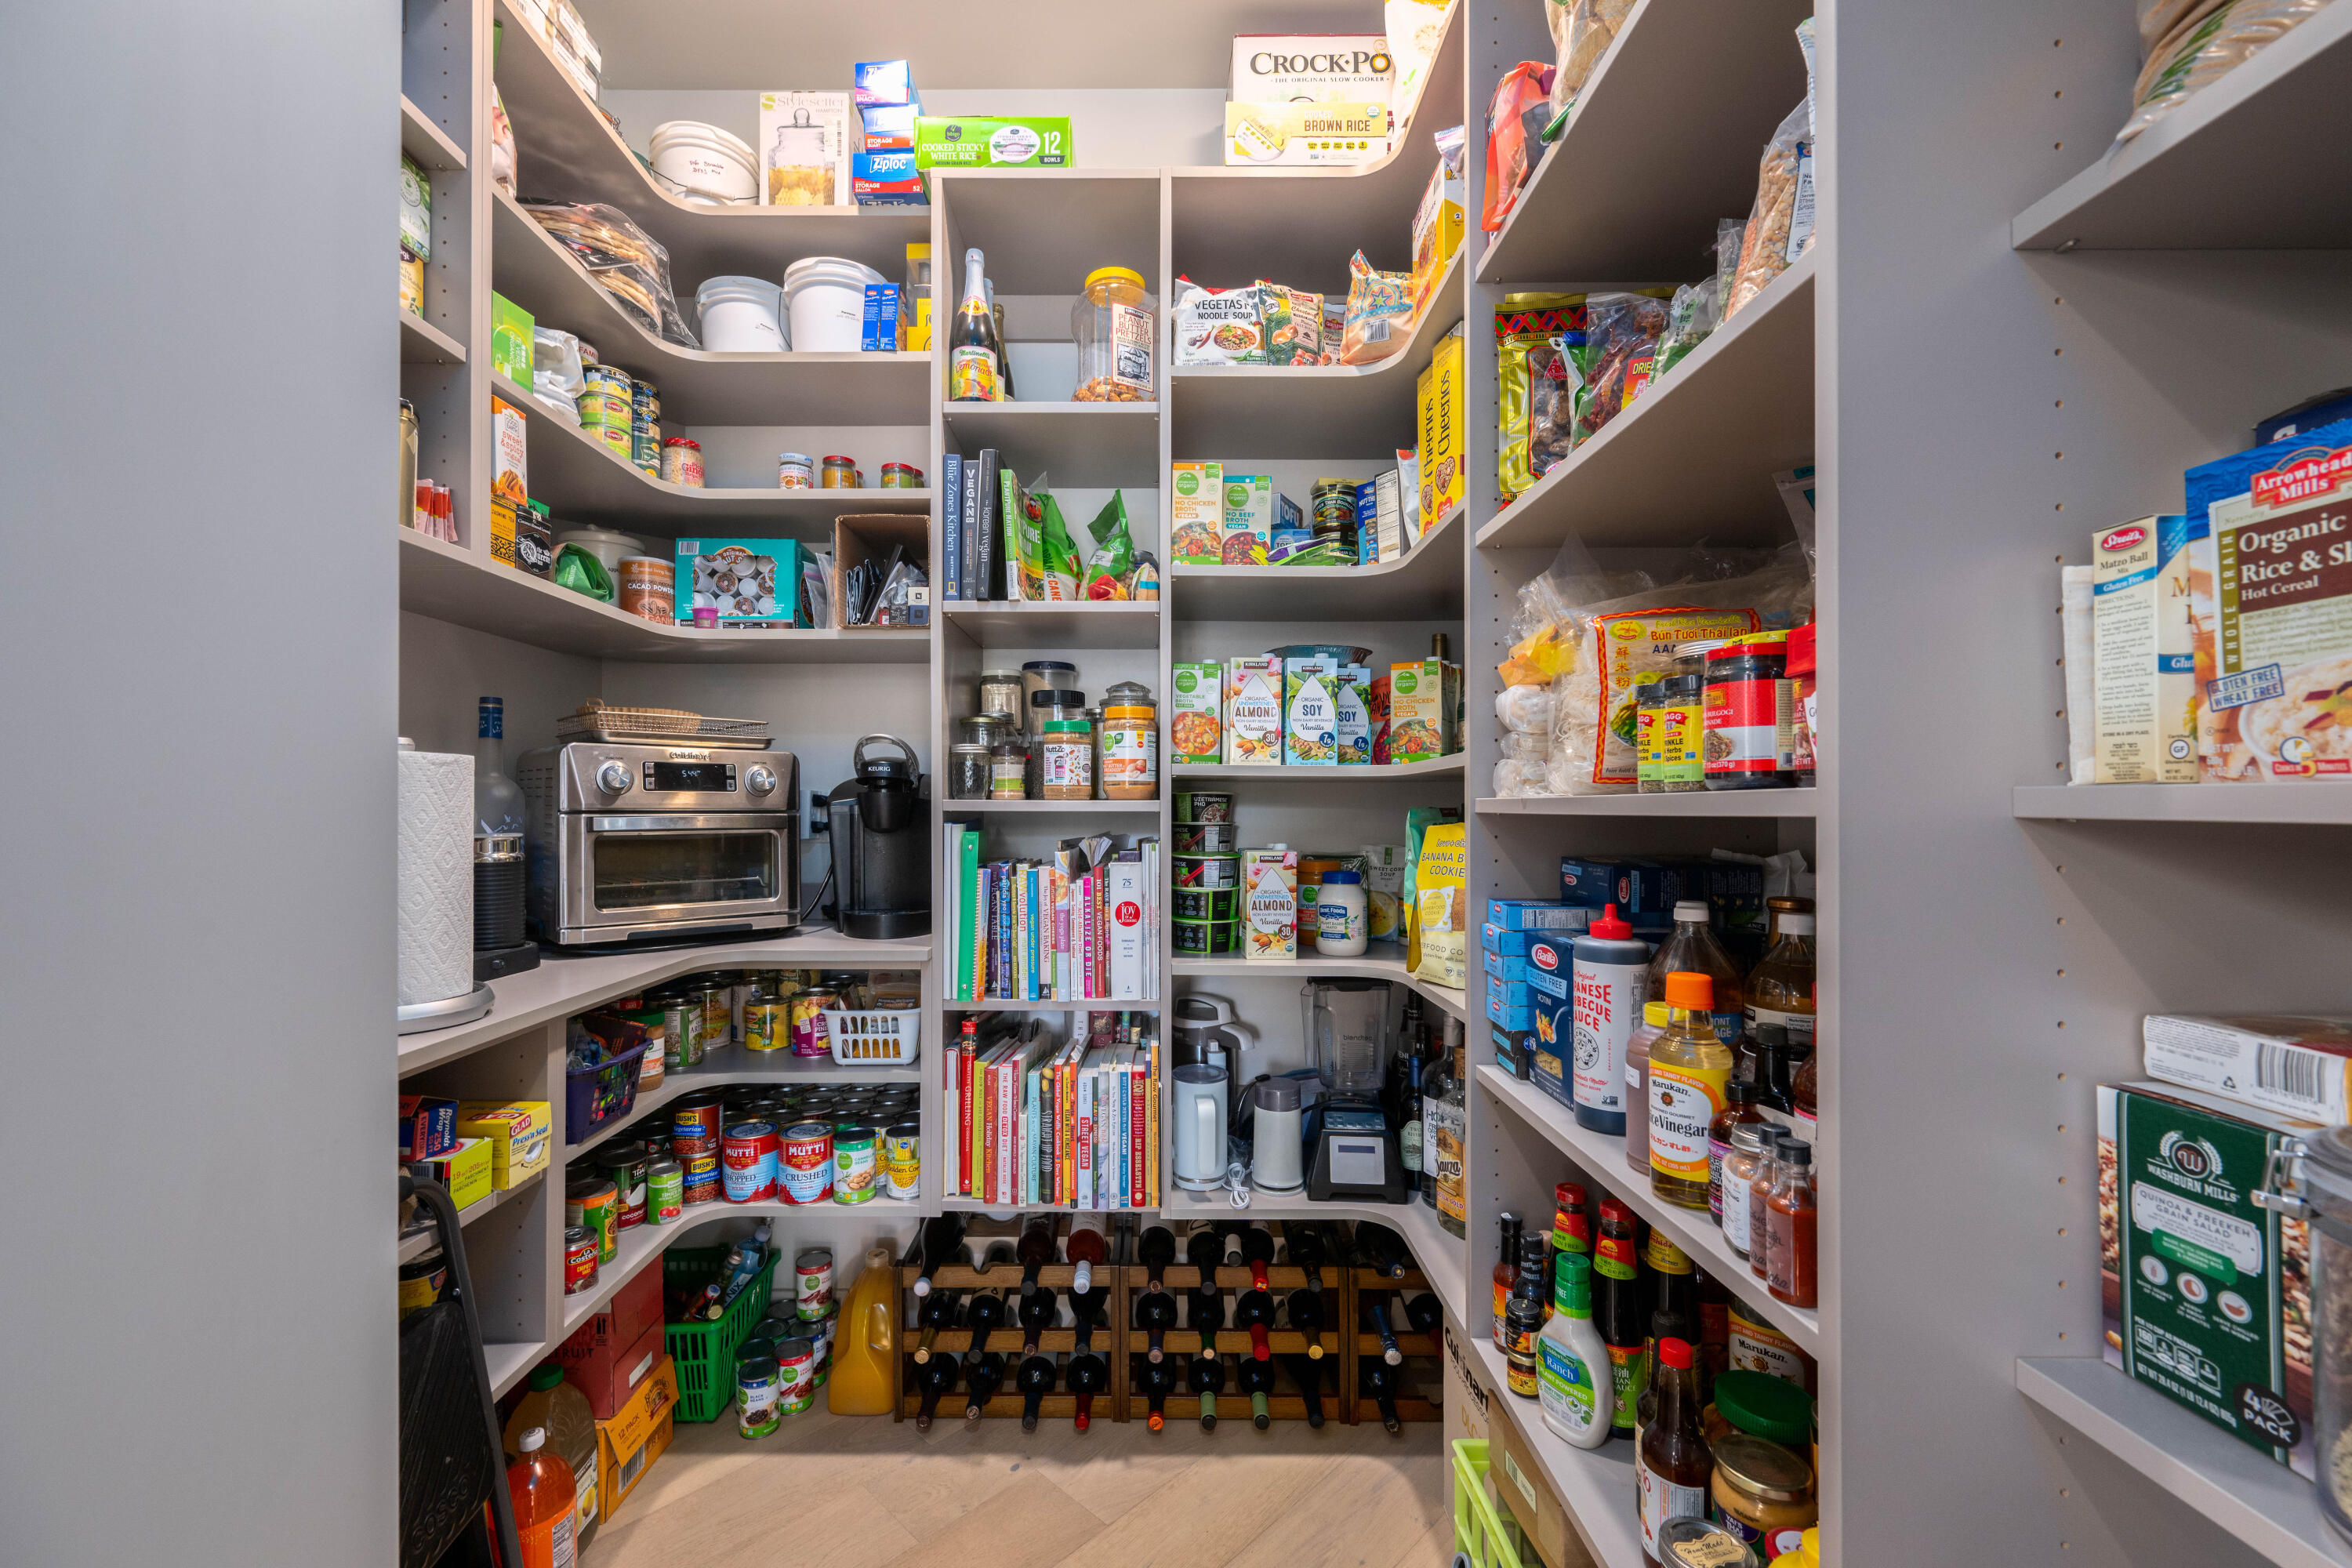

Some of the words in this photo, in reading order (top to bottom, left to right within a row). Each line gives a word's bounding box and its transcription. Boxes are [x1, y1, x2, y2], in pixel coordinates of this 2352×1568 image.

[777, 95, 844, 108] Stylesetter
[1305, 110, 1332, 118] COOKED
[1305, 120, 1342, 132] BROWN
[1347, 120, 1370, 132] RICE
[1044, 132, 1061, 154] 12
[873, 156, 906, 170] Ziploc
[931, 151, 956, 160] WHITE
[1118, 314, 1149, 328] PEANUT
[1119, 321, 1149, 336] BUTTER
[1116, 328, 1152, 344] PRETZELS
[954, 359, 993, 377] Lemonade
[1436, 368, 1450, 458] Cheerios
[502, 430, 523, 448] sweet
[948, 459, 956, 481] Blue
[948, 484, 956, 512] Zones
[2278, 477, 2329, 502] Mills
[492, 509, 506, 520] JASMINE
[982, 506, 992, 533] Korean
[948, 514, 956, 551] Kitchen
[2238, 511, 2347, 556] Organic
[2100, 556, 2127, 572] Matzo
[2128, 552, 2149, 565] Ball
[2221, 534, 2237, 590] GRAIN
[2240, 554, 2294, 585] Rice
[2299, 550, 2323, 572] &
[2102, 578, 2125, 593] Gluten
[2126, 573, 2145, 586] Free
[2241, 586, 2267, 601] Hot
[2270, 575, 2320, 597] Cereal
[1650, 630, 1671, 641] Bún
[1700, 628, 1726, 639] Thái
[2225, 604, 2240, 664] WHOLE
[2210, 673, 2249, 695] GLUTEN
[2251, 667, 2278, 684] FREE
[2212, 688, 2249, 710] WHEAT
[2253, 683, 2280, 696] FREE
[1235, 706, 1277, 717] ALMOND
[1302, 705, 1322, 716] SOY
[1338, 711, 1356, 721] SOY
[1265, 733, 1276, 743] 30
[669, 751, 712, 760] Cuisinart
[1421, 852, 1453, 862] BANANA
[1118, 904, 1136, 923] joy
[1252, 900, 1292, 911] ALMOND
[1281, 927, 1290, 936] 30
[1085, 946, 1091, 957] OR
[1537, 949, 1555, 965] Barilla
[1529, 969, 1547, 984] GLUTEN
[1548, 977, 1563, 990] FREE
[1537, 993, 1552, 1006] ROTINI
[1652, 1079, 1688, 1096] Marukan
[677, 1113, 698, 1122] BUSH'S
[1668, 1111, 1696, 1120] GOURMET
[444, 1108, 452, 1147] Reynolds
[511, 1117, 531, 1136] GLAD
[512, 1132, 535, 1146] Press'n
[535, 1123, 548, 1136] Seal
[434, 1132, 442, 1150] 250
[788, 1144, 825, 1156] MUTTI
[726, 1147, 754, 1156] MUTTI
[692, 1159, 715, 1172] BUSH'S
[1436, 1150, 1461, 1178] Sauza
[687, 1171, 719, 1181] Vegetarian
[785, 1170, 827, 1181] CRUSHED
[2147, 1163, 2201, 1194] WASHBURN
[2204, 1183, 2238, 1203] MILLS
[2140, 1189, 2181, 1210] QUINOA
[2186, 1207, 2192, 1216] &
[2197, 1211, 2250, 1238] FREEKEH
[2157, 1204, 2189, 1222] GRAIN
[2194, 1219, 2231, 1239] SALAD
[577, 1261, 593, 1272] CHIPOTLE
[1738, 1338, 1784, 1363] Marukan
[1546, 1355, 1574, 1381] Ranch
[1540, 1367, 1555, 1382] PLANT
[1555, 1378, 1588, 1401] POWERED
[2243, 1388, 2261, 1410] 4
[2243, 1409, 2293, 1443] PACK
